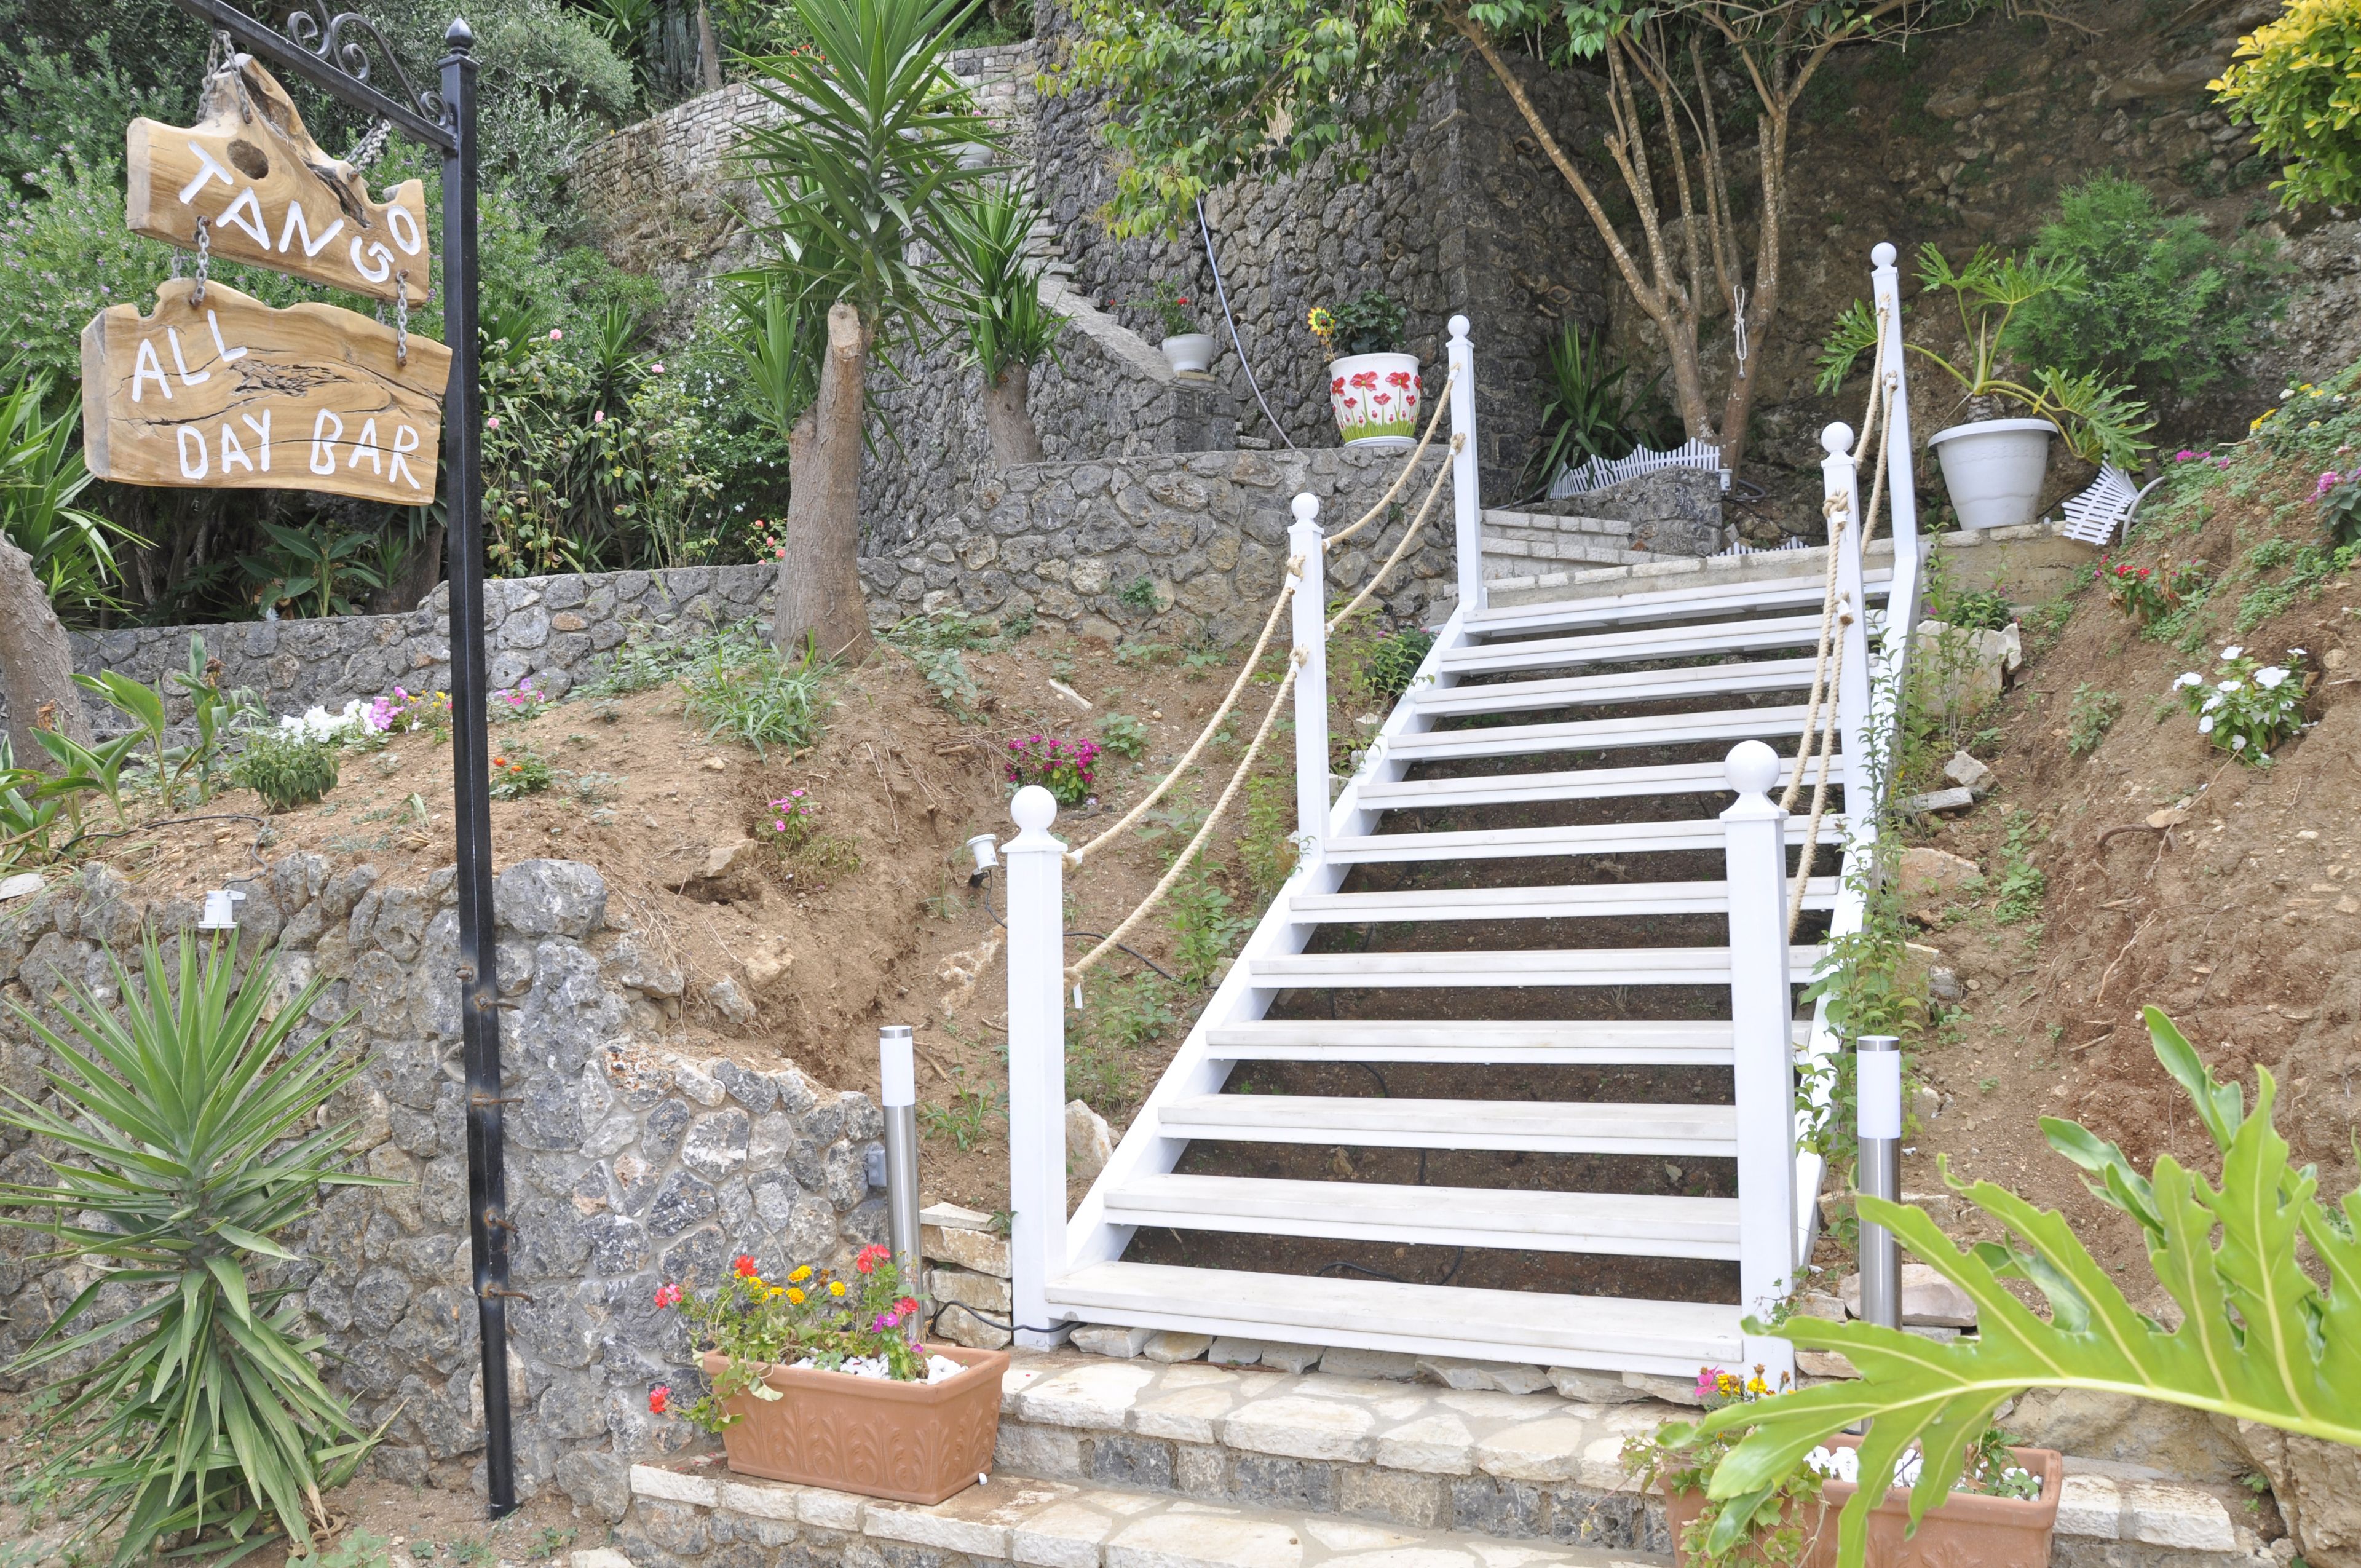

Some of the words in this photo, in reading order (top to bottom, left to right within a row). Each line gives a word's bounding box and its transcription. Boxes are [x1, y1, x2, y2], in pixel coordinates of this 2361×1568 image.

[178, 140, 422, 284] TANGO
[131, 309, 247, 402] ALL
[176, 409, 271, 480] DAY
[309, 408, 421, 490] BAR
